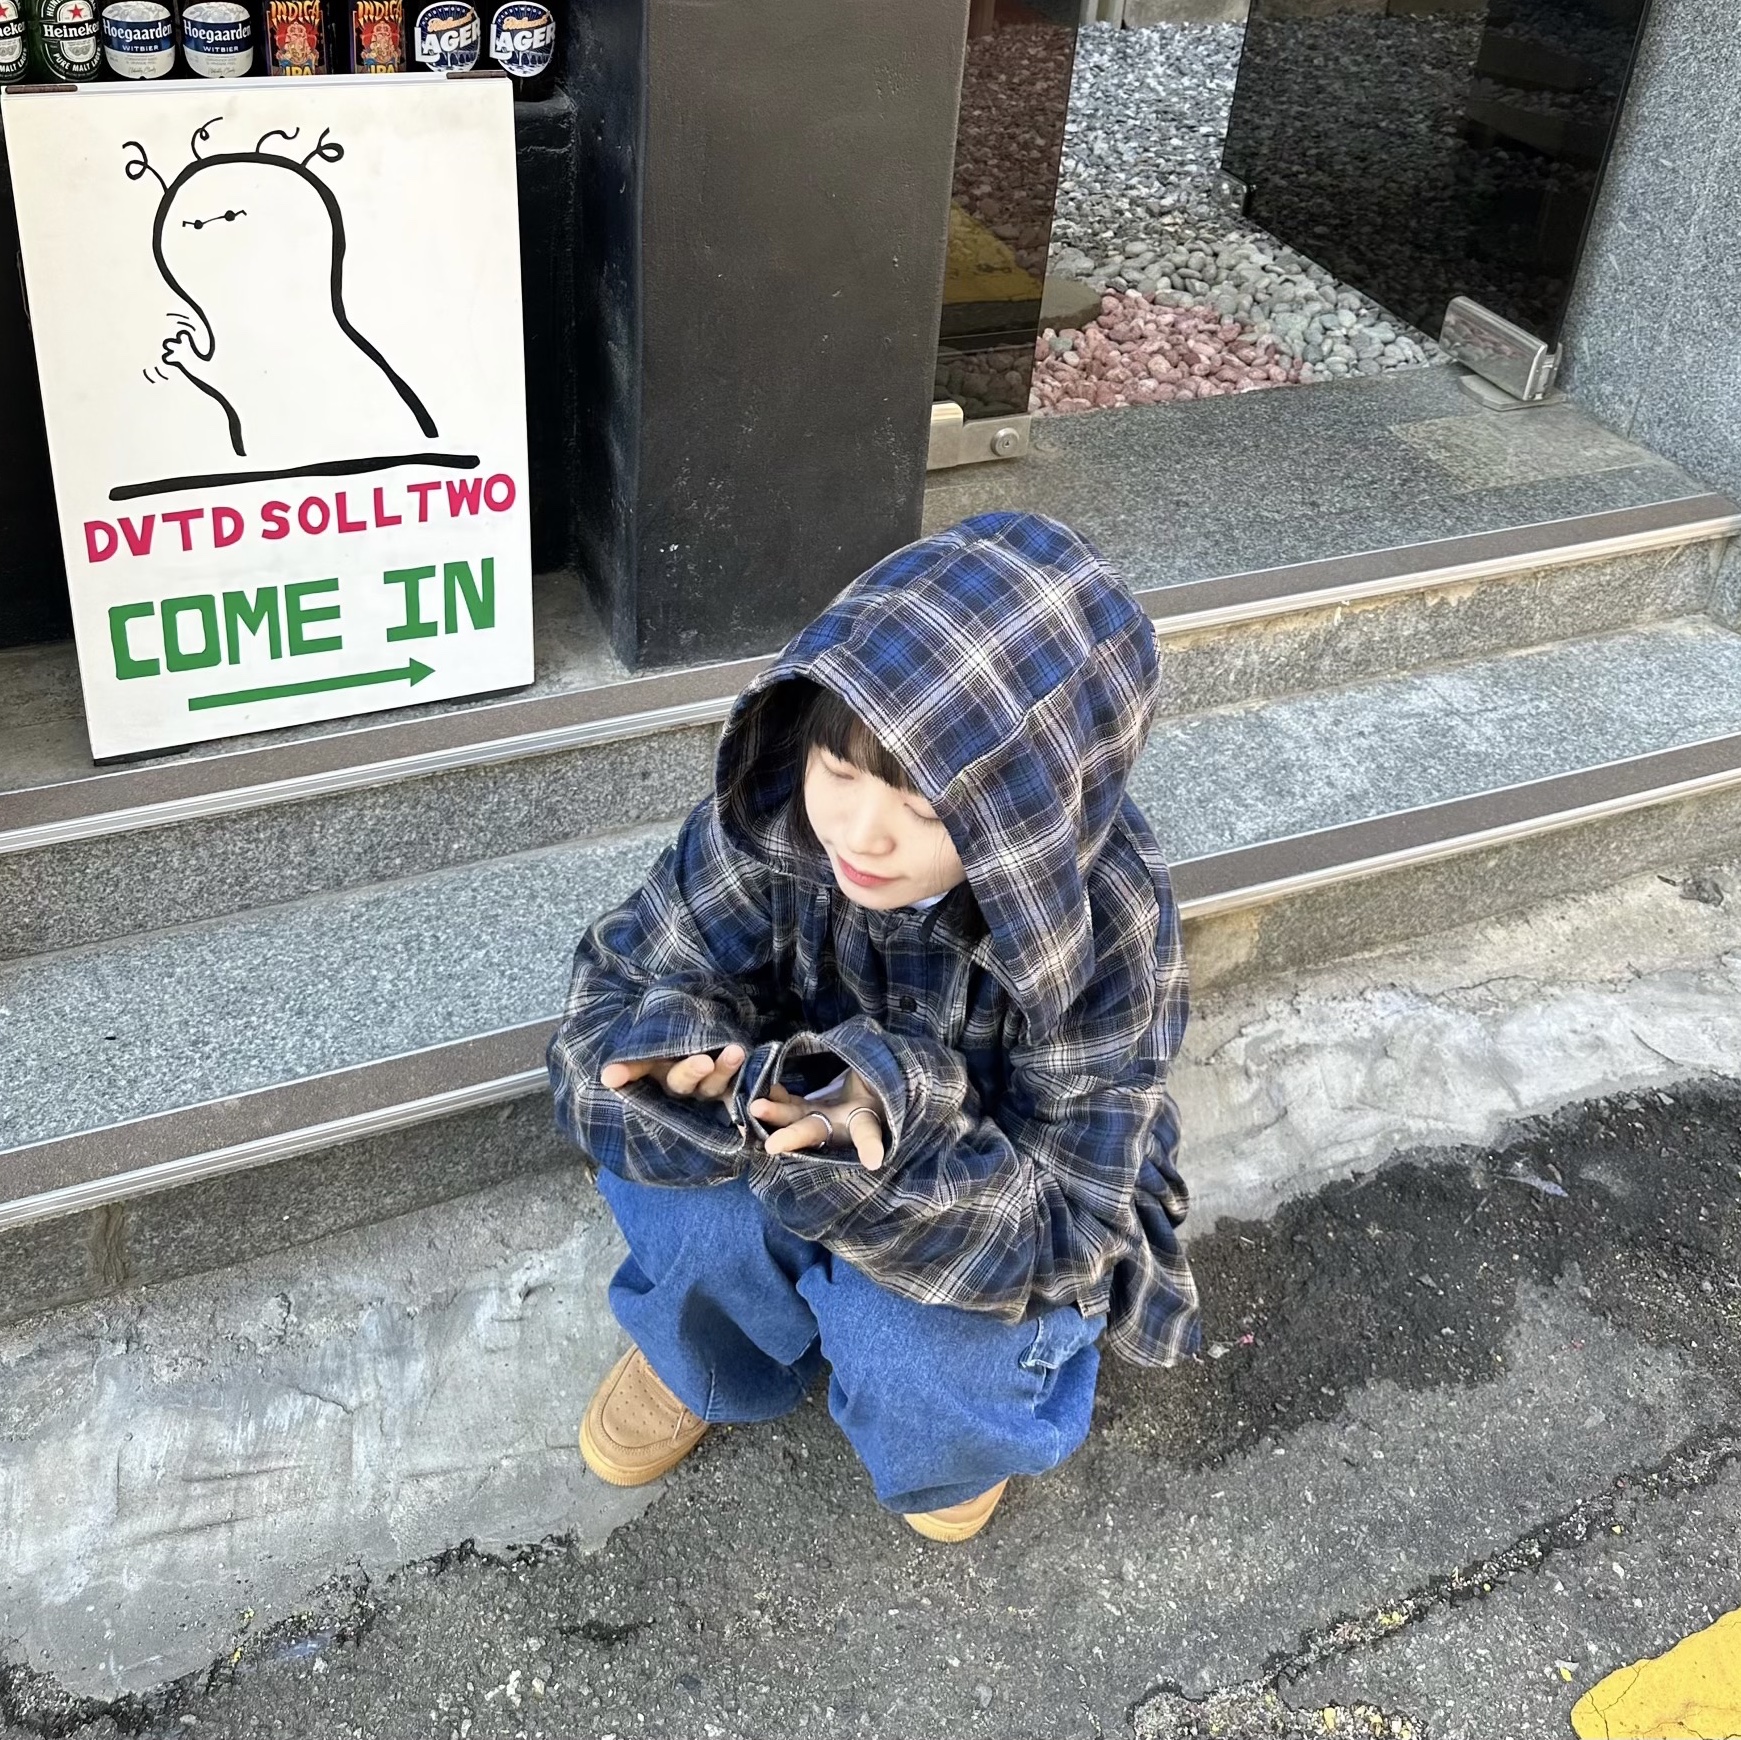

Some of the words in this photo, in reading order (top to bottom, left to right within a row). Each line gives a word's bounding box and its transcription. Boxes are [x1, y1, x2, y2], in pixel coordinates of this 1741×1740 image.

[269, 0, 320, 27] INDICA
[356, 0, 403, 27] INDICA
[102, 18, 173, 43] Hoegaarden
[183, 19, 252, 44] Hoegaarden
[414, 18, 481, 62] LAGER
[489, 21, 556, 60] LAGER
[122, 44, 159, 52] WITBIER
[203, 45, 239, 53] WITBIER
[53, 52, 71, 70] PURE
[72, 62, 91, 72] MALT
[84, 506, 245, 563] DVTD
[108, 578, 343, 681] COME
[383, 556, 495, 643] IN
